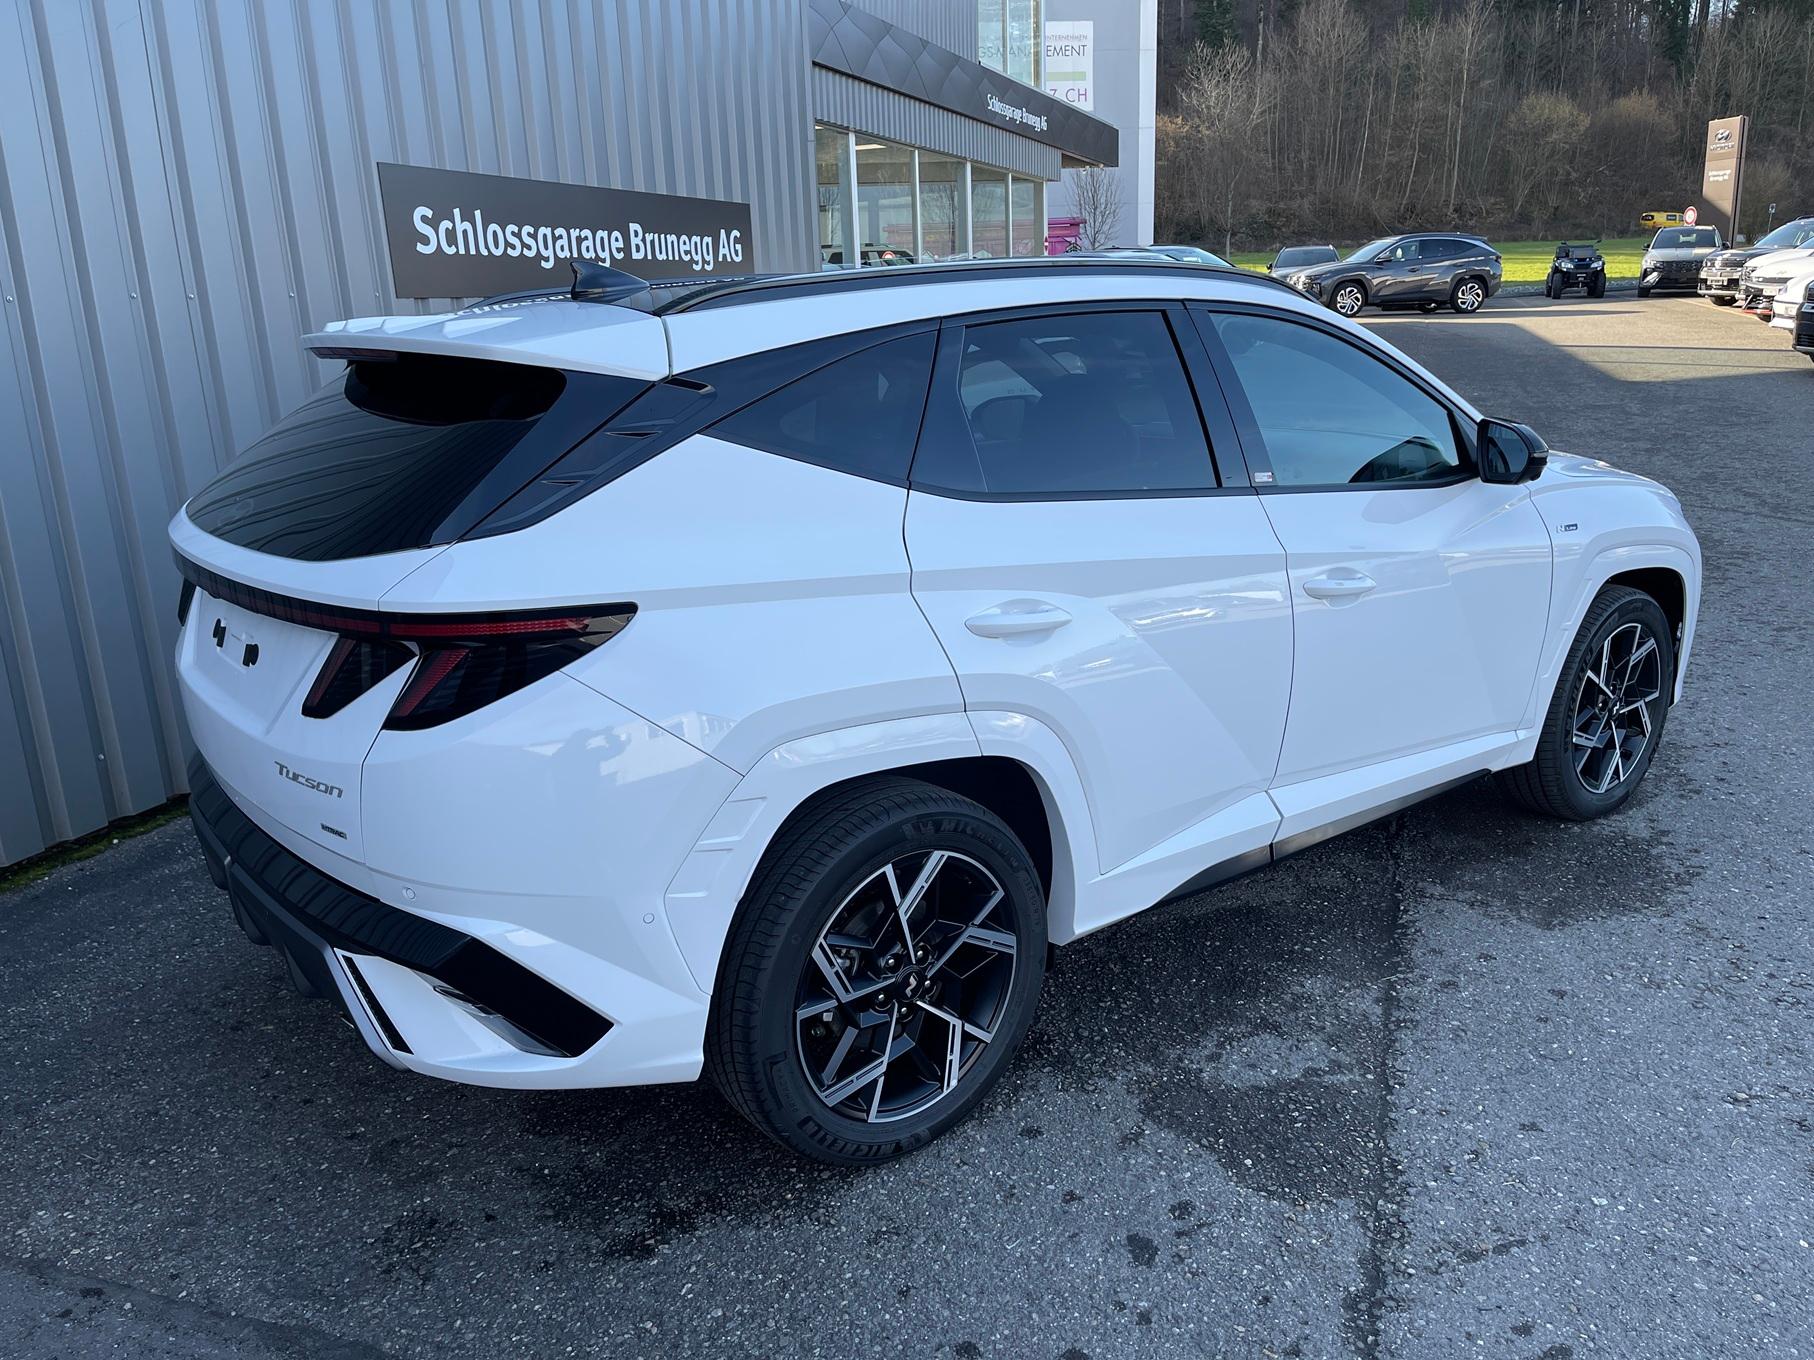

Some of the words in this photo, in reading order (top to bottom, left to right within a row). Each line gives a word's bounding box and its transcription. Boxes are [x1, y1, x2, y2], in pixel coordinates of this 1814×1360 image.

[412, 205, 625, 269] Schlossgarage
[628, 222, 714, 271] Brunegg
[717, 228, 744, 263] AG
